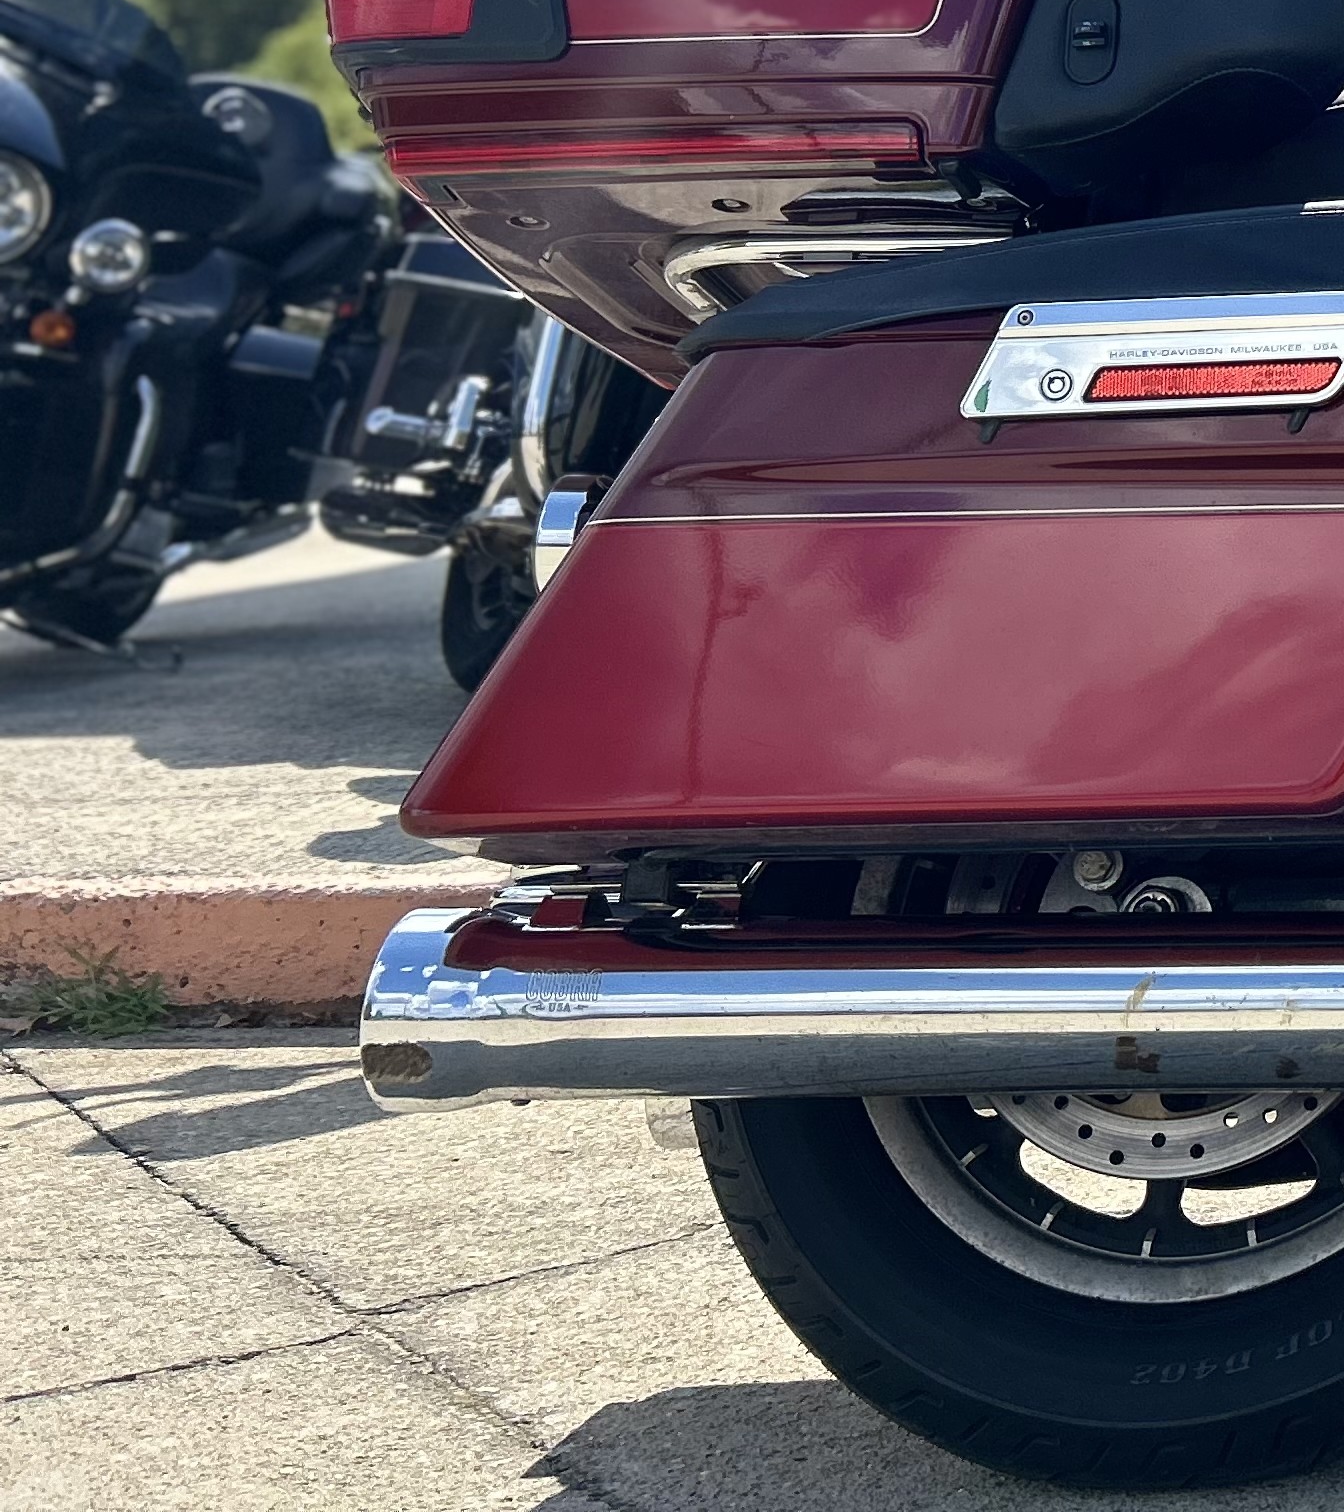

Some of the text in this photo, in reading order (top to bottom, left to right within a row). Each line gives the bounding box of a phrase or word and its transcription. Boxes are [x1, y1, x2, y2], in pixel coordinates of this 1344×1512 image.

[1109, 347, 1224, 361] HARLEY-DAVIDSON
[1313, 342, 1338, 351] USA
[526, 968, 603, 1001] COBRA
[548, 1002, 571, 1013] USA
[1130, 1348, 1255, 1384] D402
